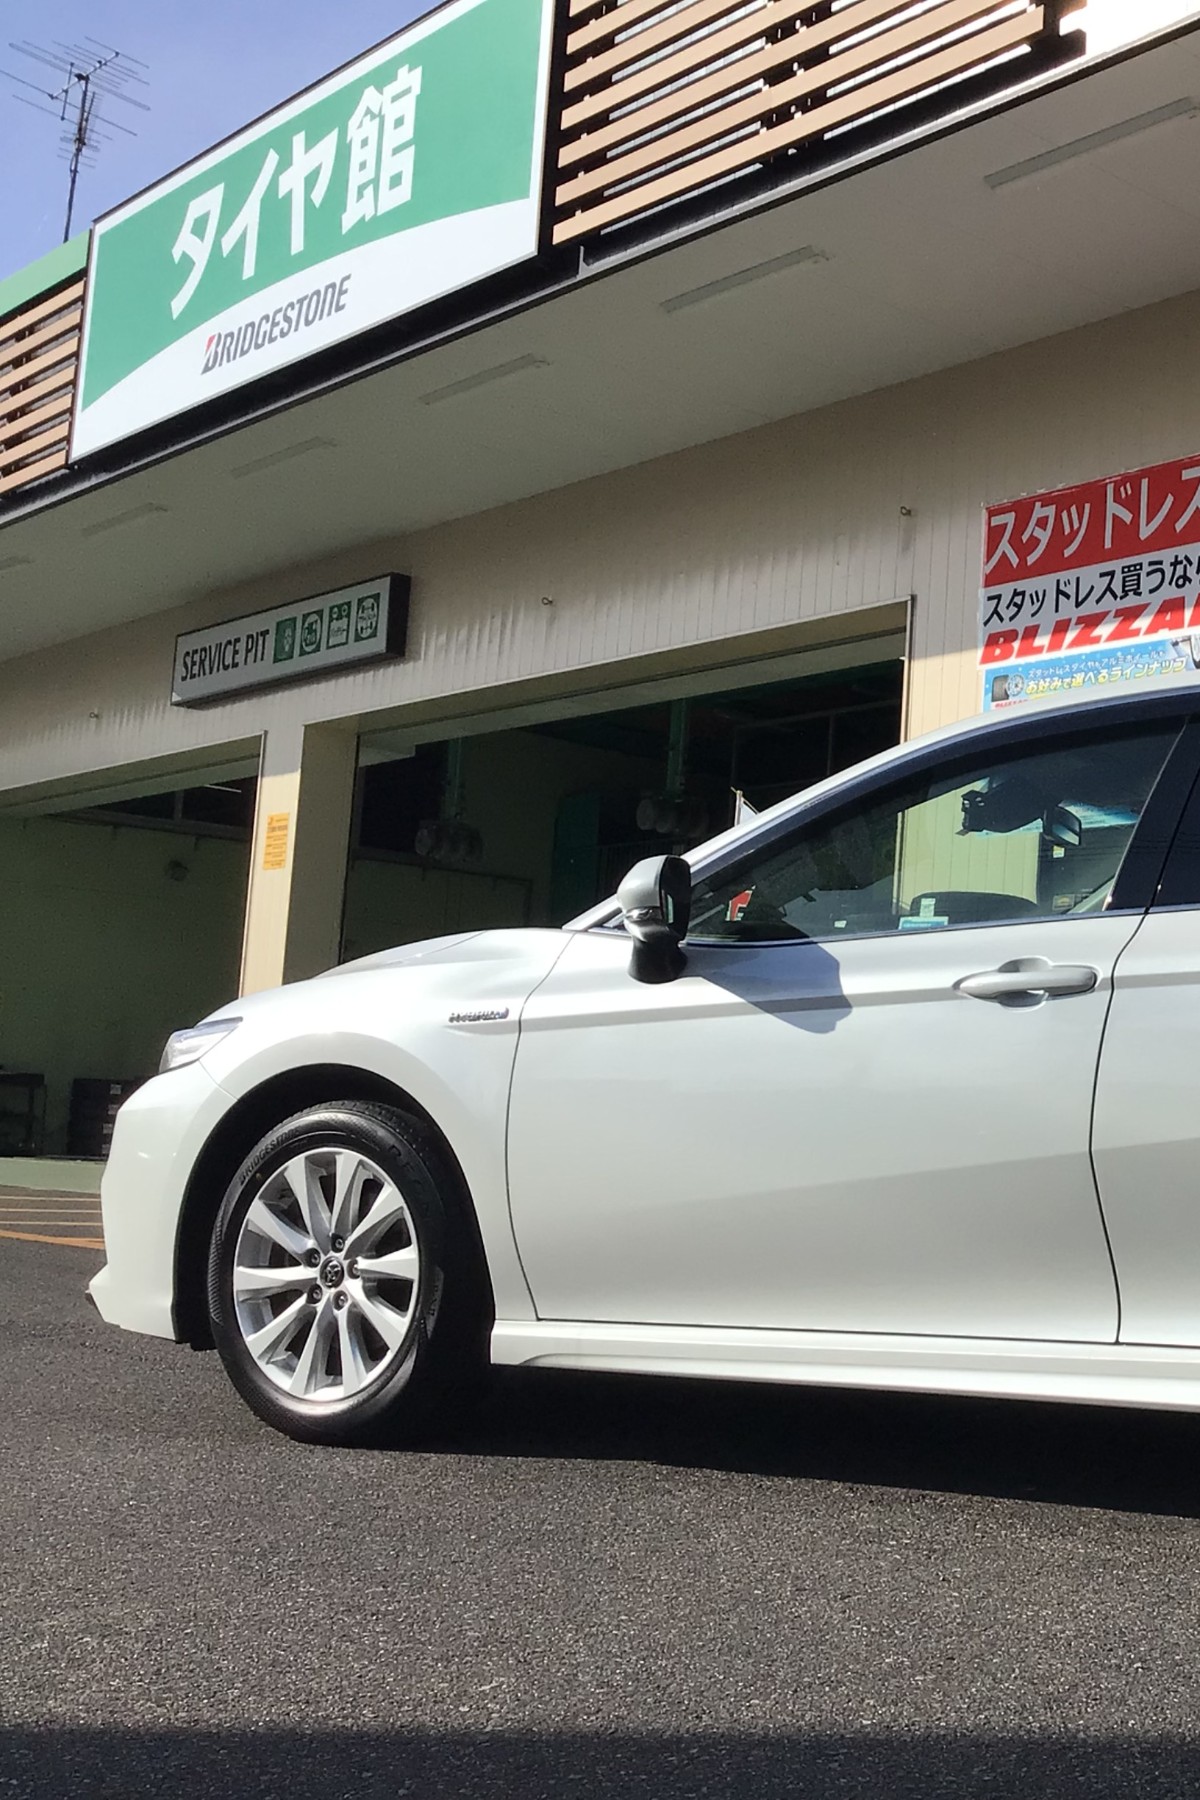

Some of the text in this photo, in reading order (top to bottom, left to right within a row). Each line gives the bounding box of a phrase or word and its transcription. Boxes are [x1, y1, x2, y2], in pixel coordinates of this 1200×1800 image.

[169, 64, 423, 321] タイヤ館
[200, 274, 352, 376] BRIDGESTONE
[181, 629, 270, 682] SERVICE PIT
